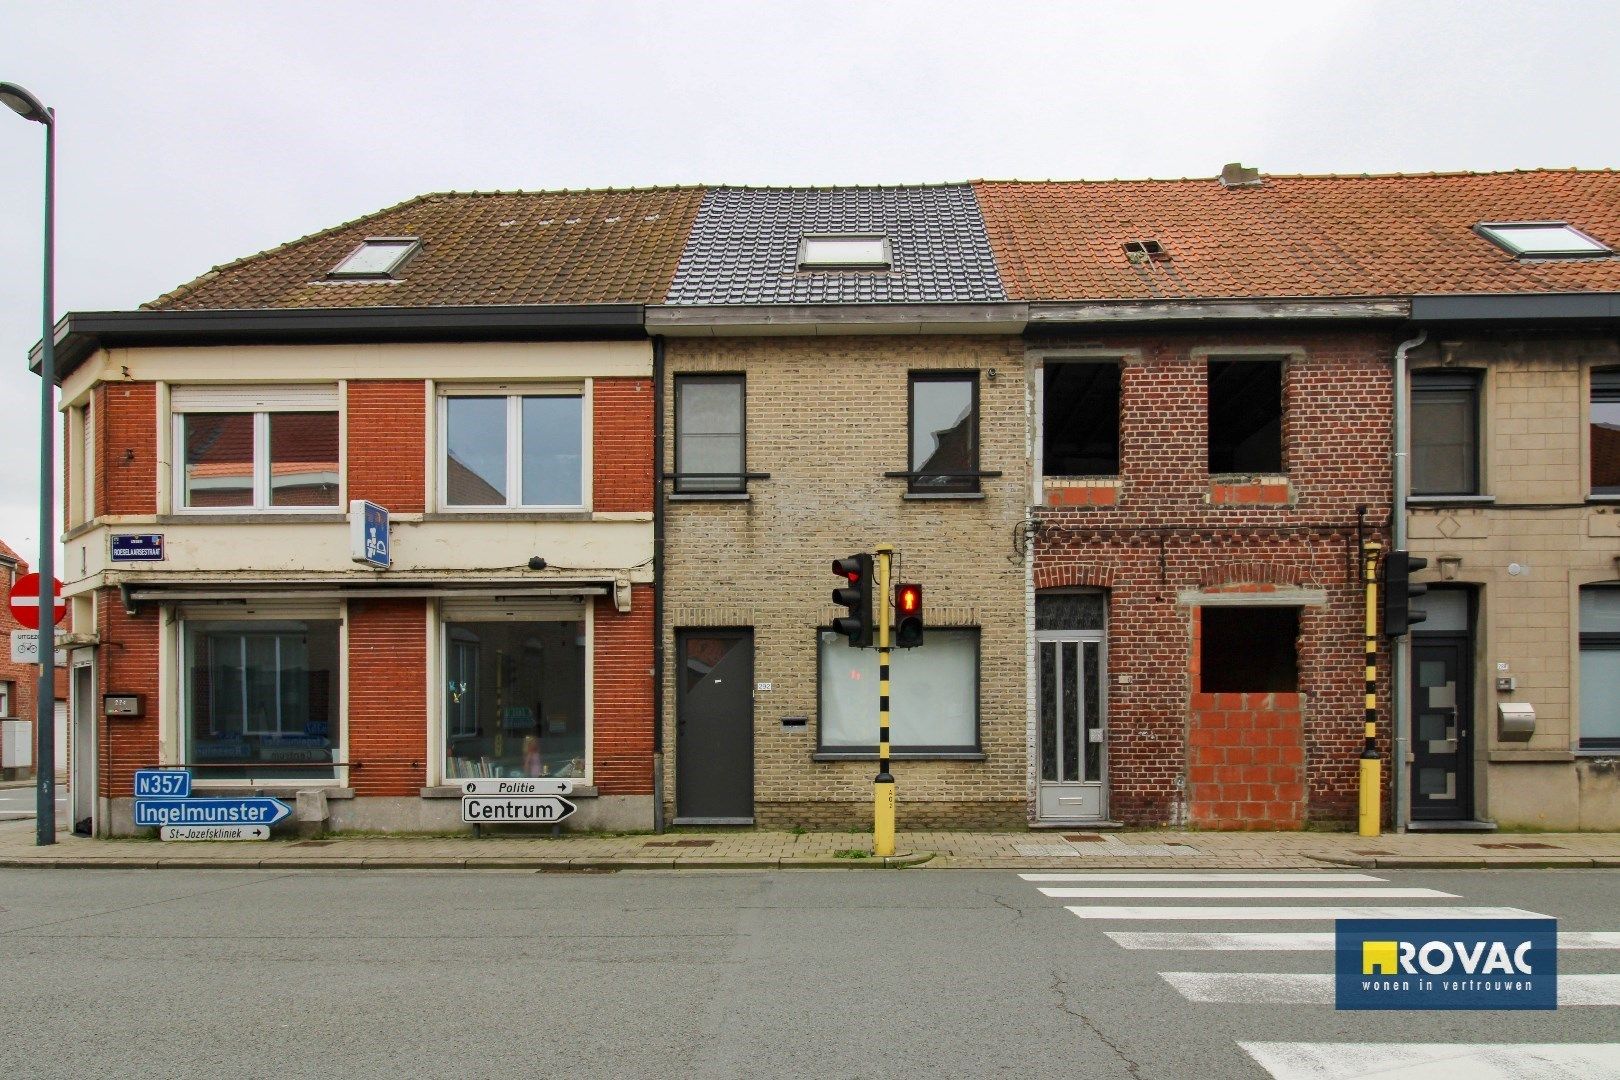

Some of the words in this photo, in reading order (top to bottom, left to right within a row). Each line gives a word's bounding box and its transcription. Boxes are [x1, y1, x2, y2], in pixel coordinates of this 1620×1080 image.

[140, 775, 184, 794] N357
[498, 782, 535, 793] Politie
[140, 803, 268, 826] Ingelmunster
[468, 800, 553, 818] Centrum
[169, 828, 242, 839] St-Jozefskliniek
